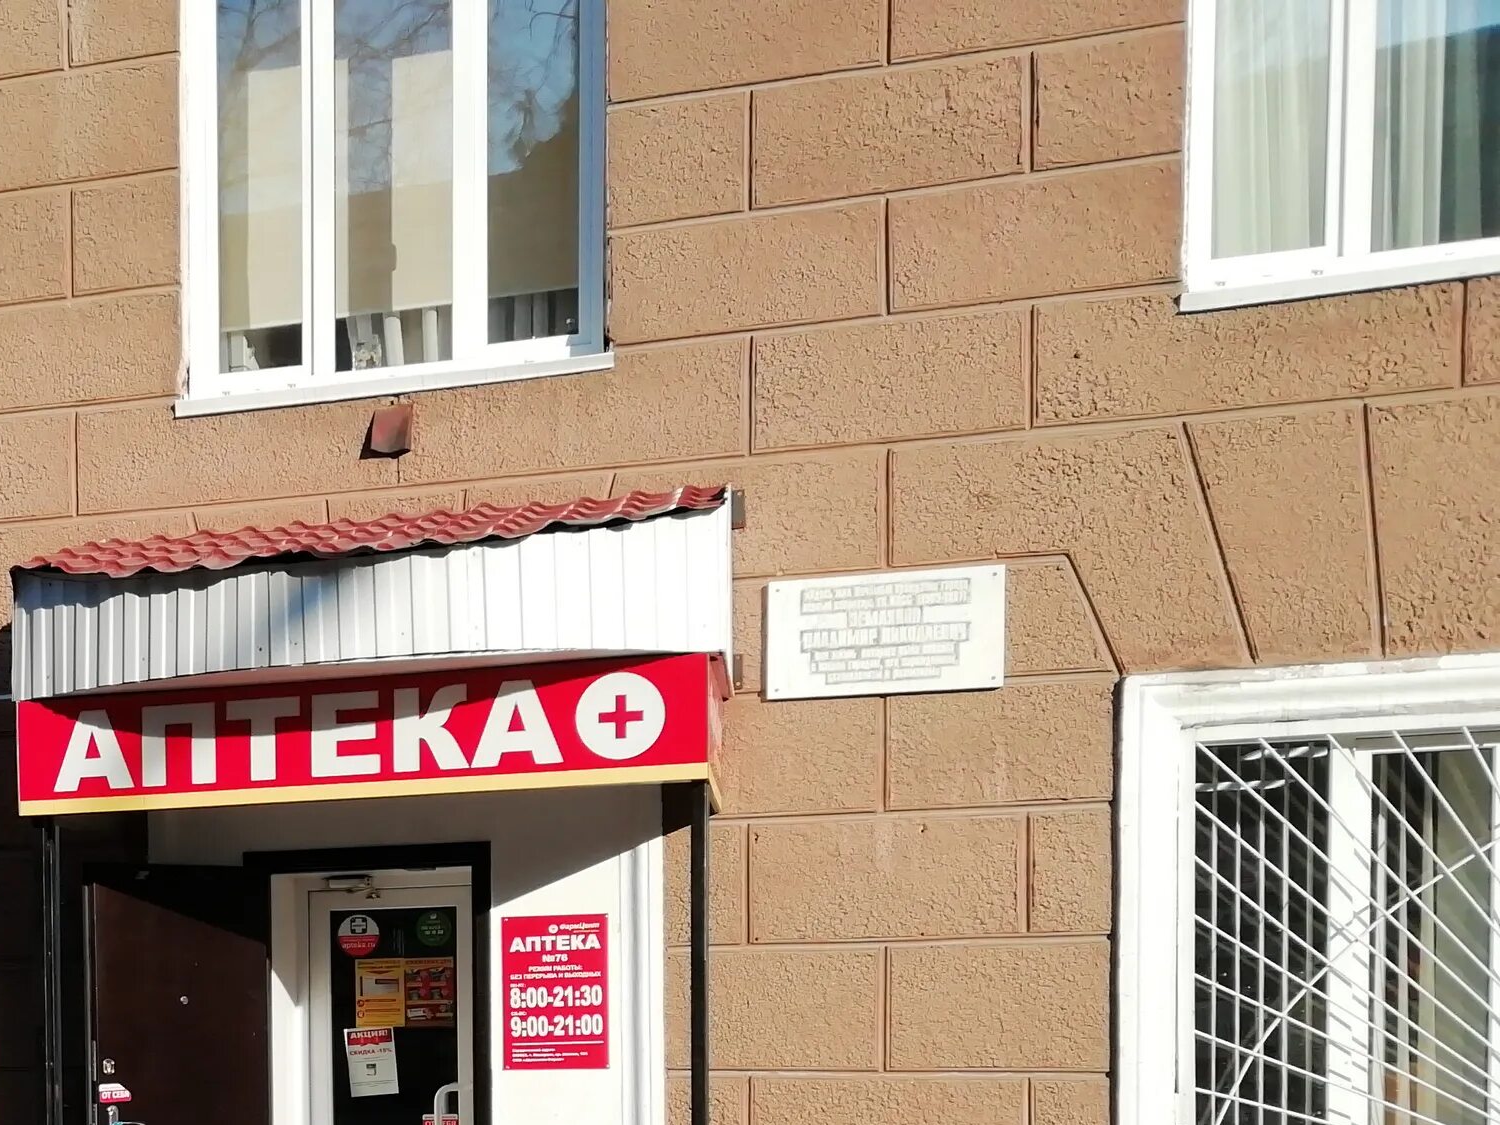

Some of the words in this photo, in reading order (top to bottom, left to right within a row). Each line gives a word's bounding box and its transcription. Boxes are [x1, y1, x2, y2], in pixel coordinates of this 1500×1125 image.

[53, 680, 564, 792] АПТЕКА
[509, 933, 602, 953] АПТЕКА
[510, 984, 603, 1009] 8:00-21:30
[350, 1029, 388, 1040] АКЦИЯ!
[510, 1013, 604, 1037] 9:00-21:00
[349, 1048, 376, 1056] СКИДКА
